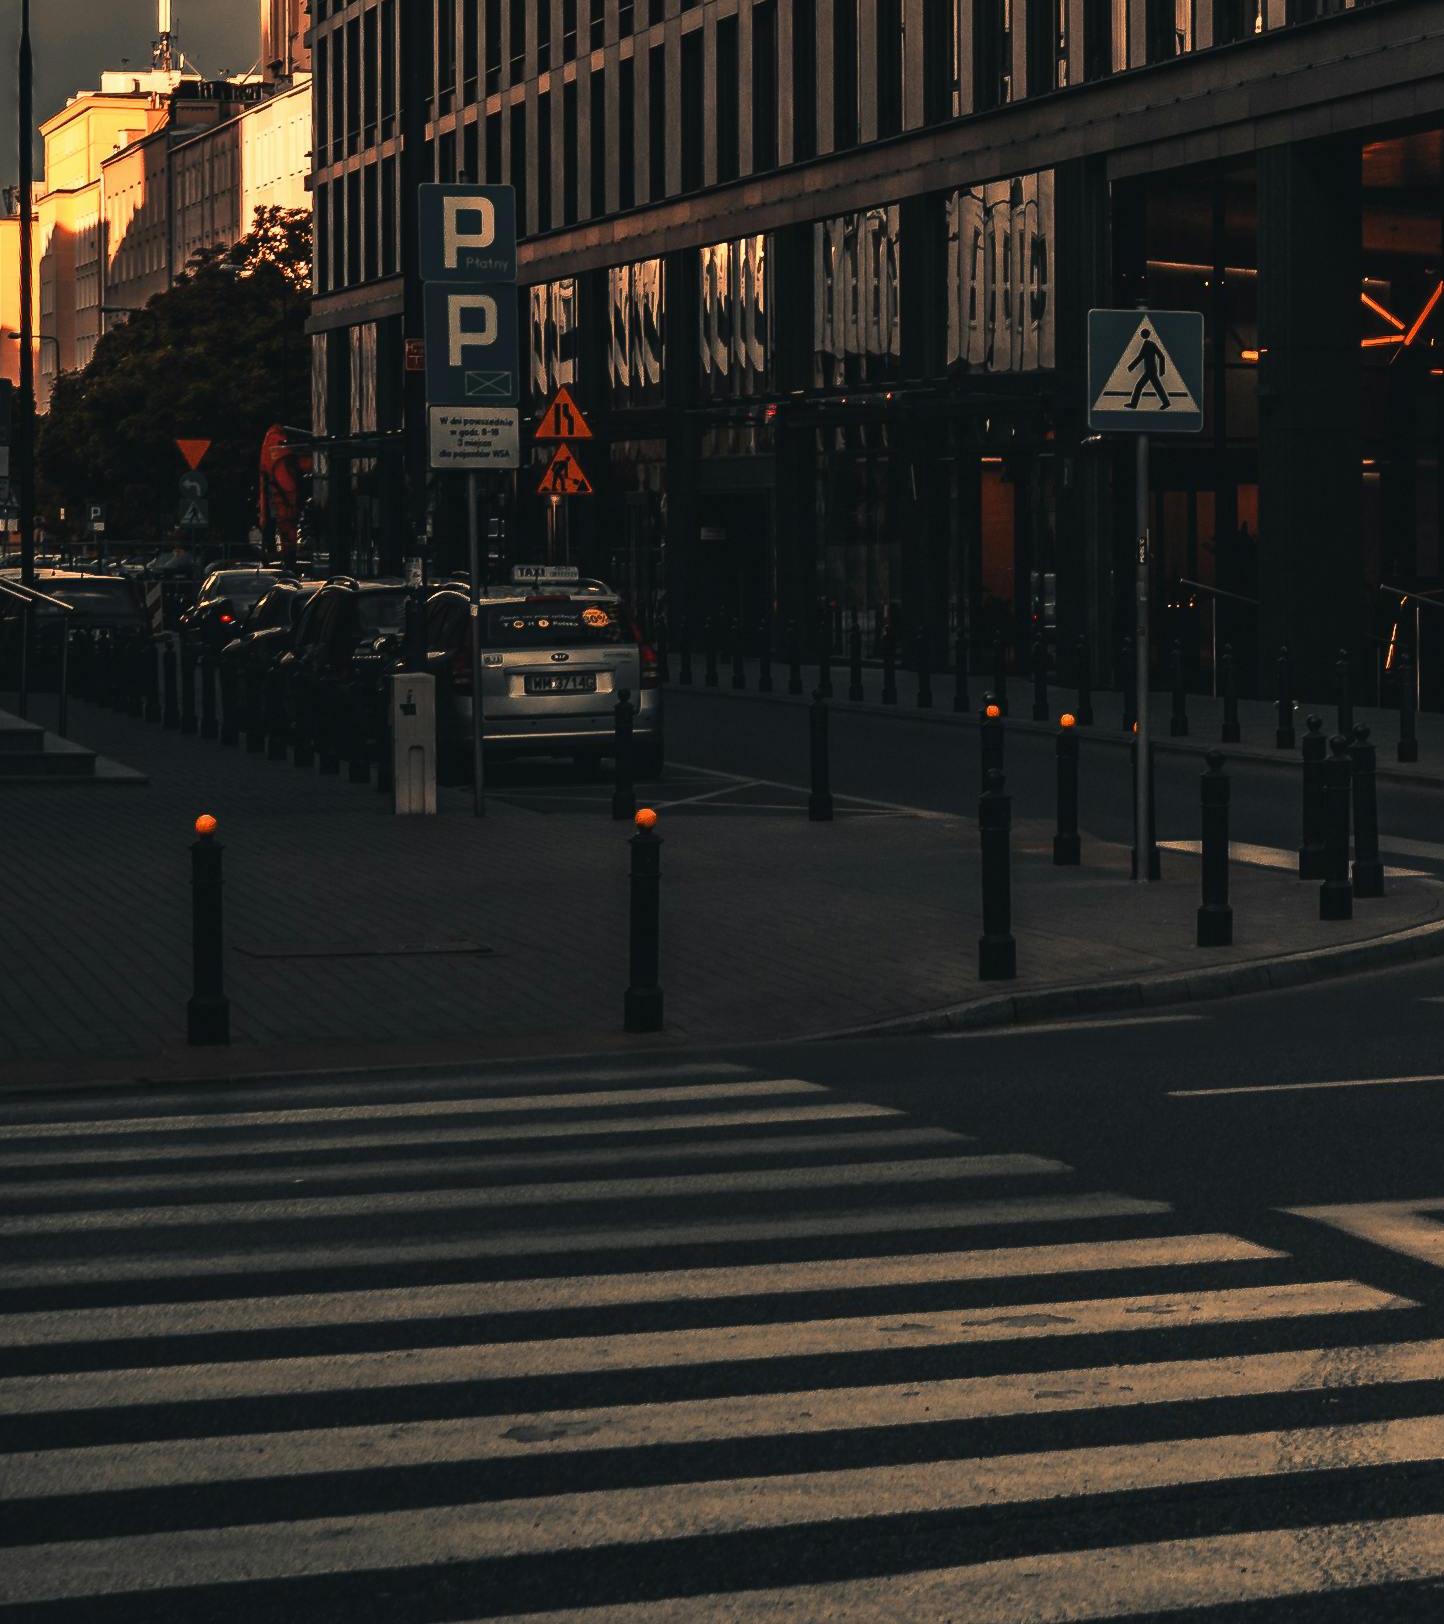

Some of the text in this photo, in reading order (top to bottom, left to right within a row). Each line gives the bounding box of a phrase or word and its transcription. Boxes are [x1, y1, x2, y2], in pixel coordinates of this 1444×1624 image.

[443, 196, 495, 268] P
[465, 256, 509, 272] Płatny
[448, 295, 497, 366] P
[91, 506, 101, 520] P
[518, 567, 545, 577] TAXI
